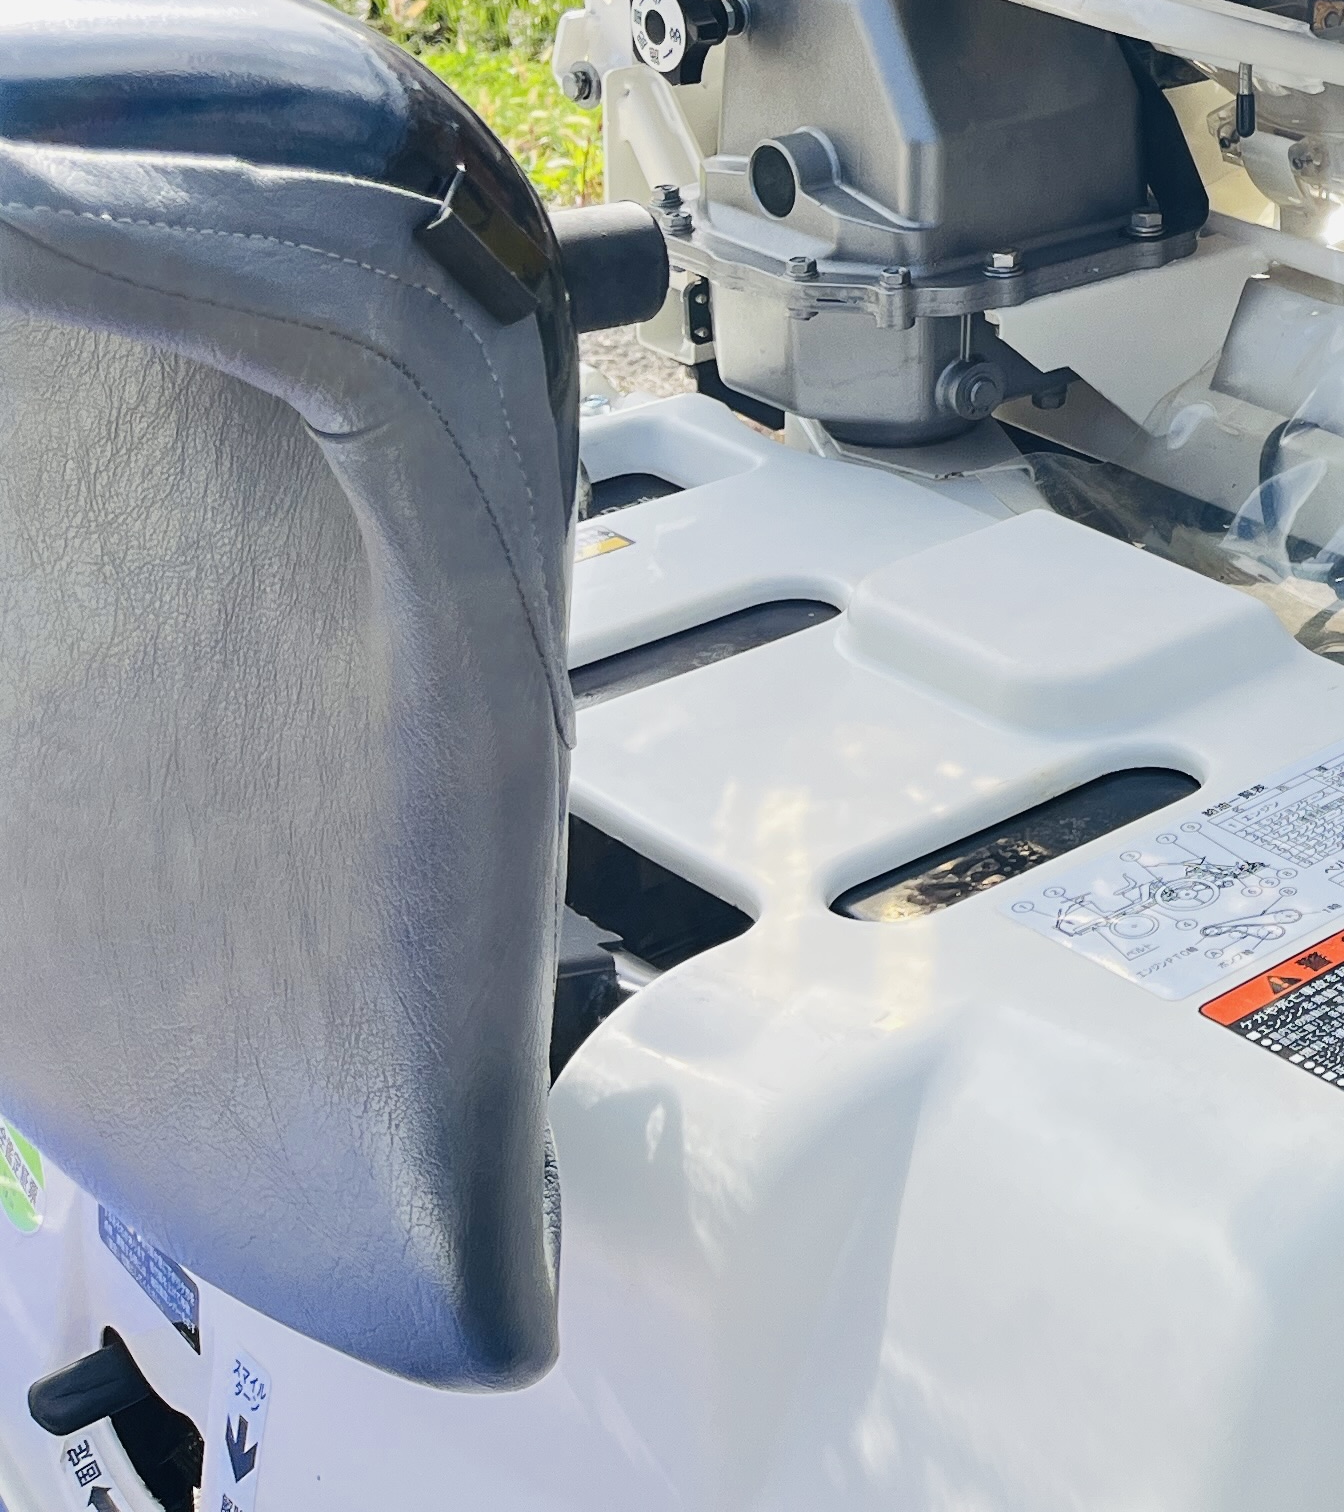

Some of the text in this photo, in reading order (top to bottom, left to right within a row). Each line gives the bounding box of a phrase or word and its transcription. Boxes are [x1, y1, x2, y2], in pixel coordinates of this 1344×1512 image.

[232, 1359, 267, 1400] スマイル
[235, 1382, 260, 1412] ターン
[66, 1439, 102, 1487] 固定
